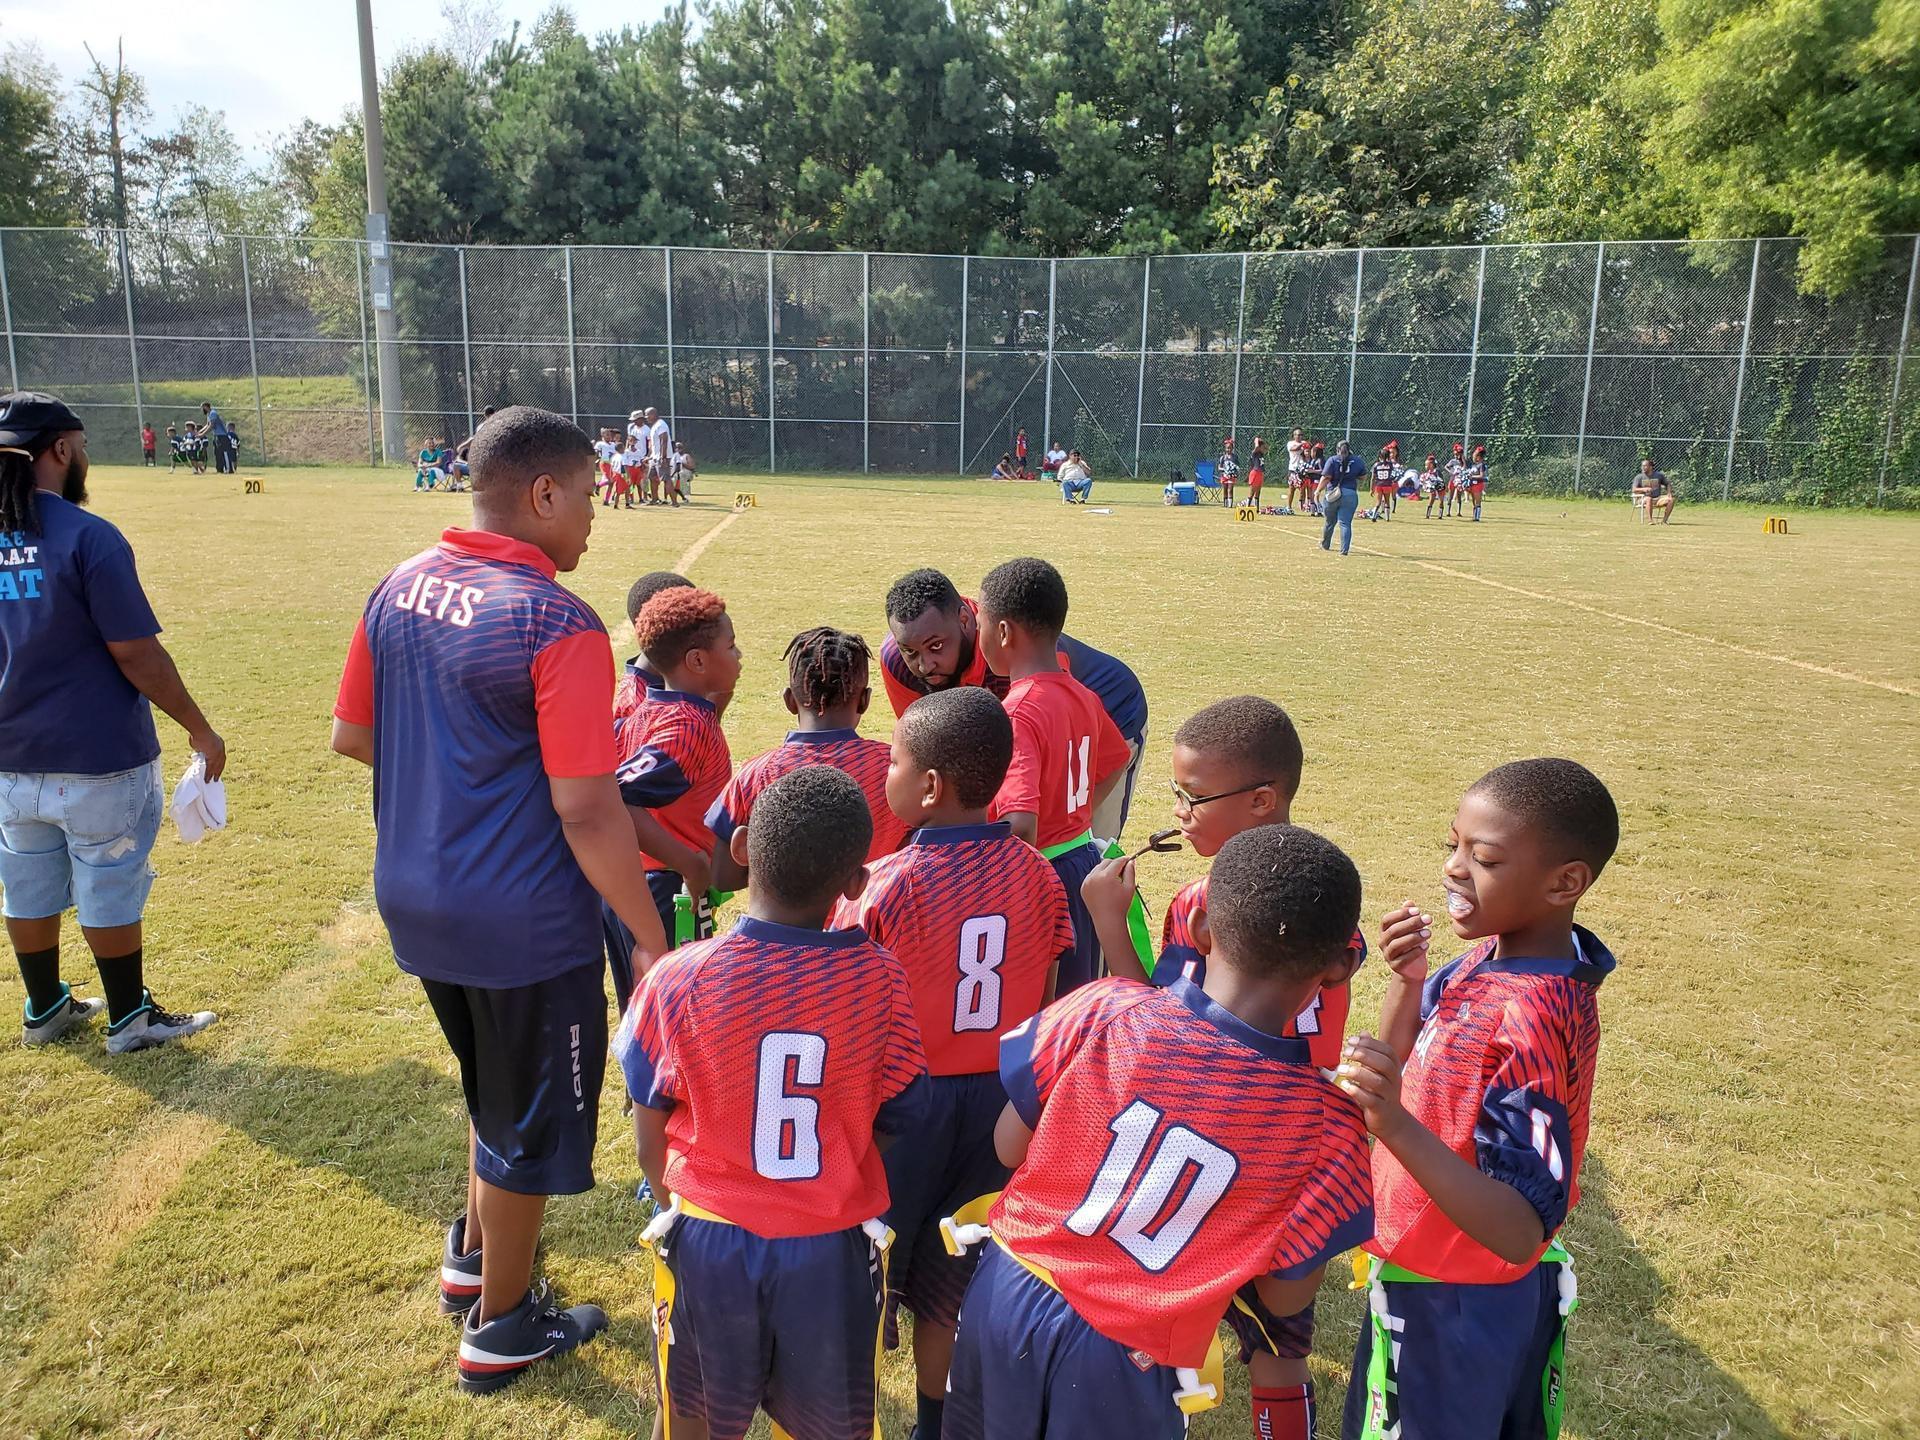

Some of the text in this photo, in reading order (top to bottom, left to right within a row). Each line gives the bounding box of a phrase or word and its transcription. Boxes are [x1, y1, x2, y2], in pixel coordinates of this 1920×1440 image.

[245, 480, 261, 494] 20
[1239, 509, 1255, 522] 20
[1769, 518, 1788, 534] 10
[395, 572, 485, 628] JETS
[953, 913, 1008, 1034] 8
[752, 1030, 829, 1182] 6
[1062, 1095, 1241, 1275] 10
[546, 1329, 565, 1339] FILA
